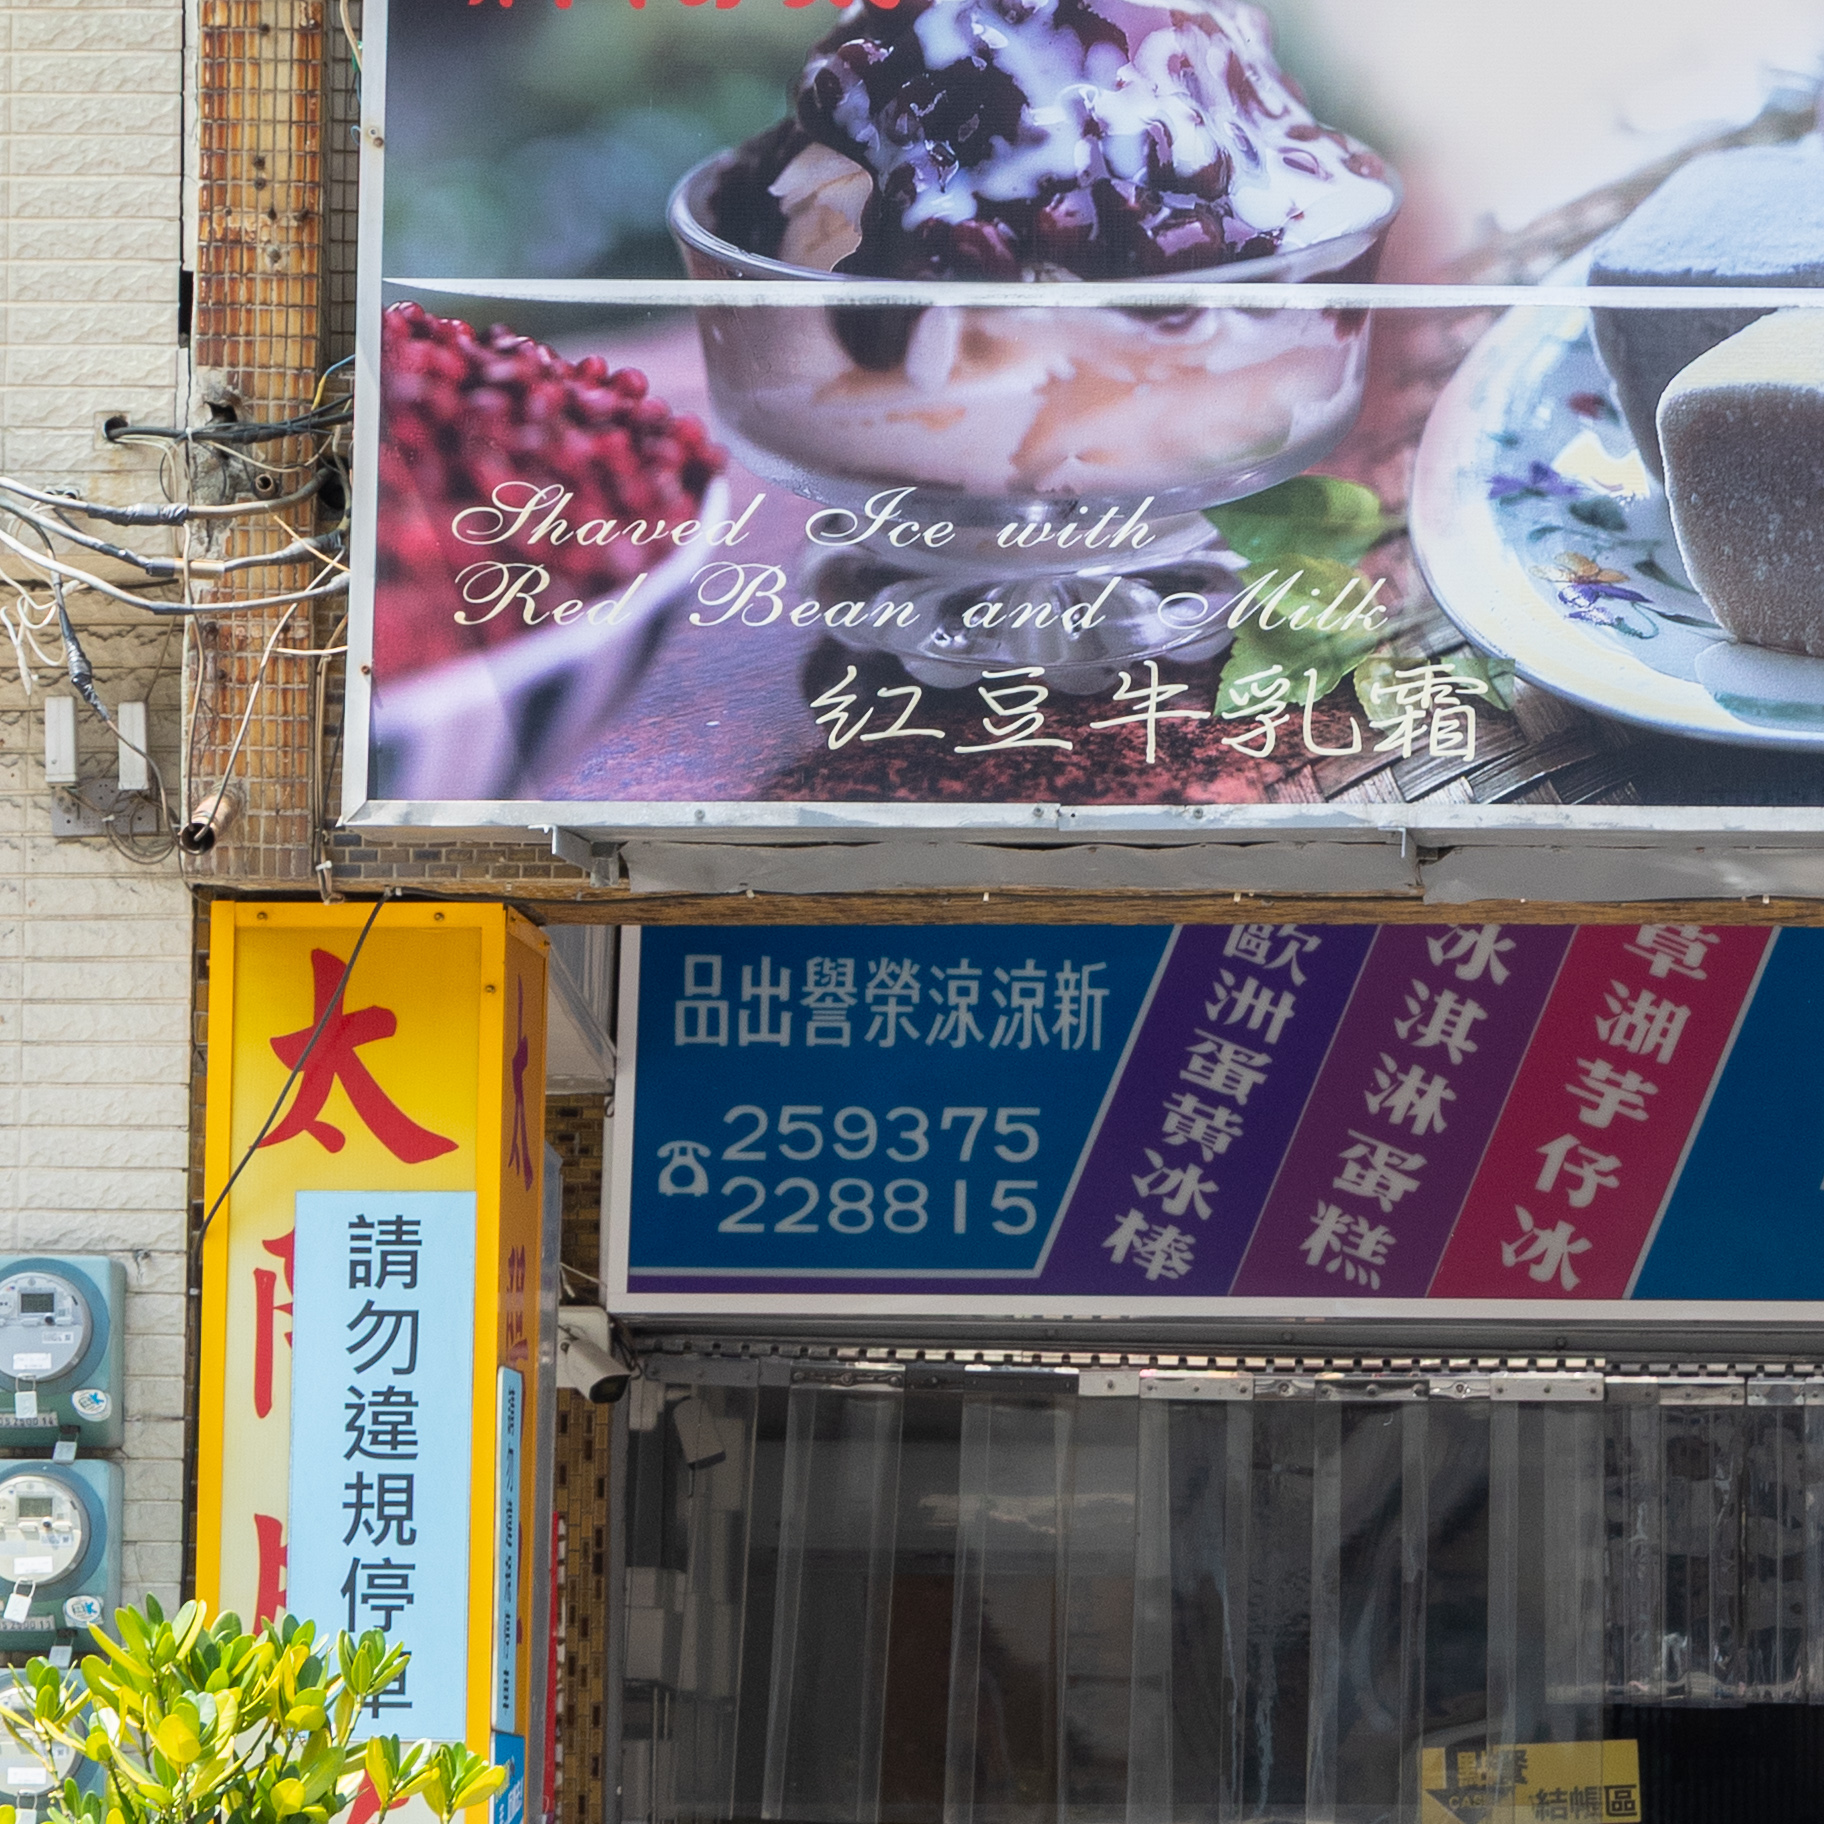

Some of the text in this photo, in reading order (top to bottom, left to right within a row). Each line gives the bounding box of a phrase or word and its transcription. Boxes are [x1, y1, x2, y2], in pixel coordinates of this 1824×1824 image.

[451, 481, 1157, 548] Shaved Ice with
[452, 561, 1388, 634] Red Bean and Milk
[718, 1180, 1039, 1236] 228815
[721, 1104, 1041, 1162] 259375
[1100, 923, 1322, 1282] 歐洲蛋黃冰棒
[1300, 923, 1516, 1290] 冰淇淋蛋糕
[1500, 923, 1721, 1291] 草湖芋仔冰
[340, 1215, 422, 1719] 請勿違規停車
